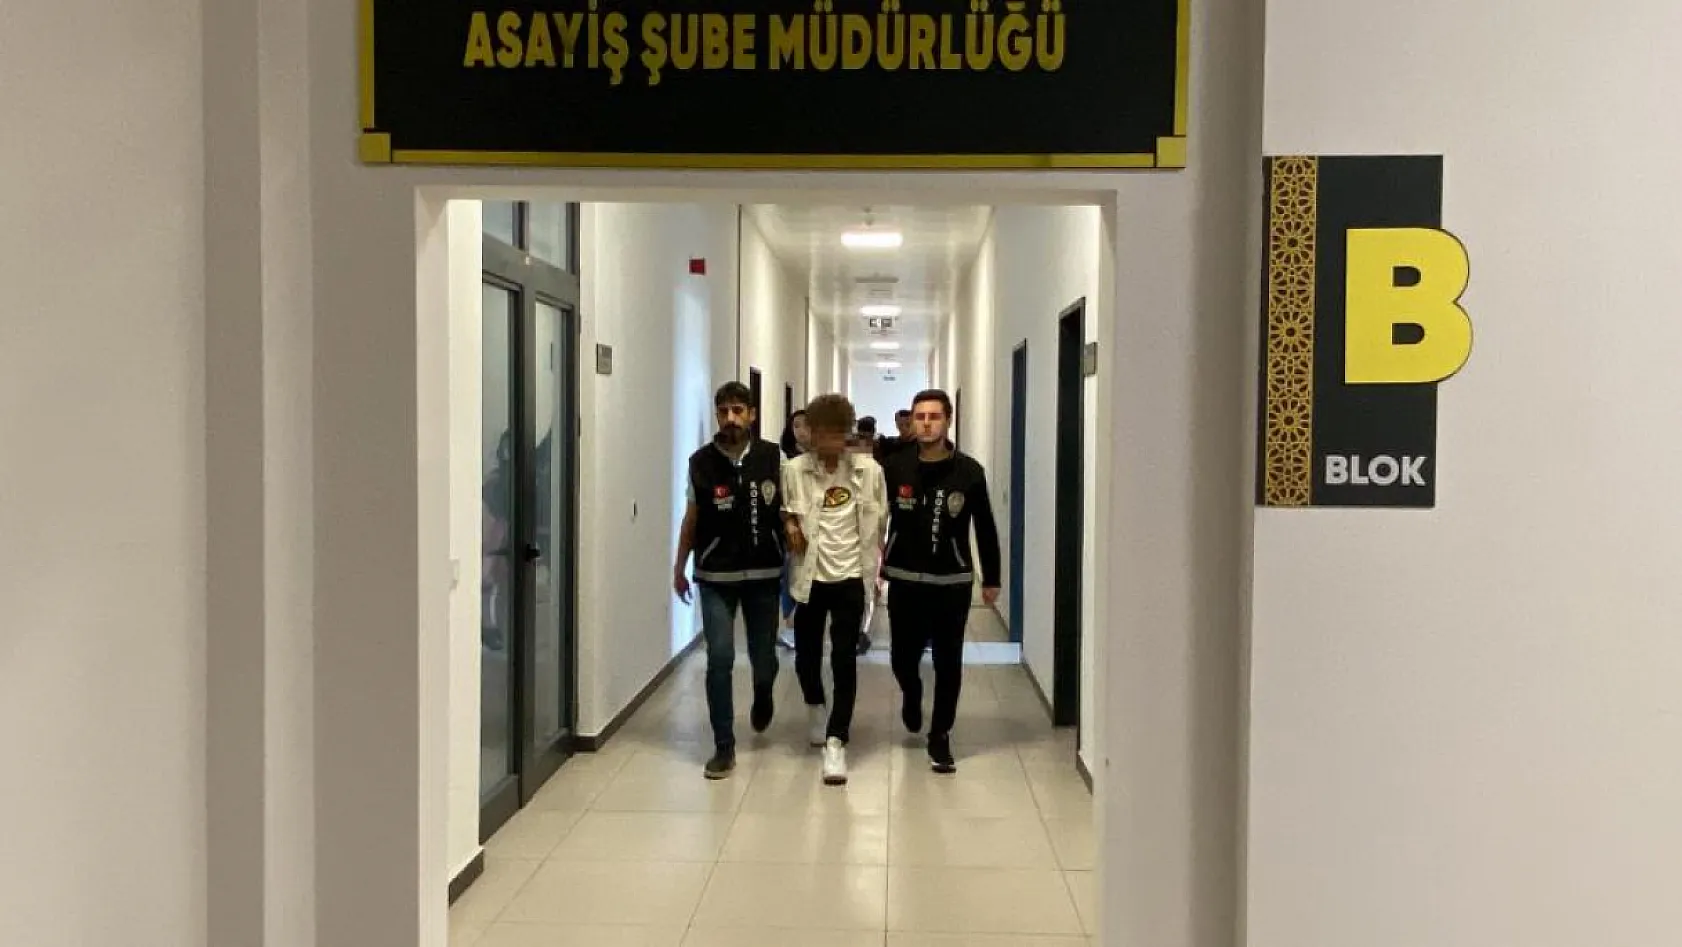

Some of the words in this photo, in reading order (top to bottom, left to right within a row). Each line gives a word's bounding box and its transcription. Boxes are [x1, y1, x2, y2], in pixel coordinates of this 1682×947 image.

[463, 0, 629, 85] ASAYİŞ
[640, 11, 756, 85] ŞUBE
[768, 0, 1066, 71] MÜDÜRLÜĞÜ
[1345, 228, 1473, 385] B
[1324, 455, 1427, 487] BLOK
